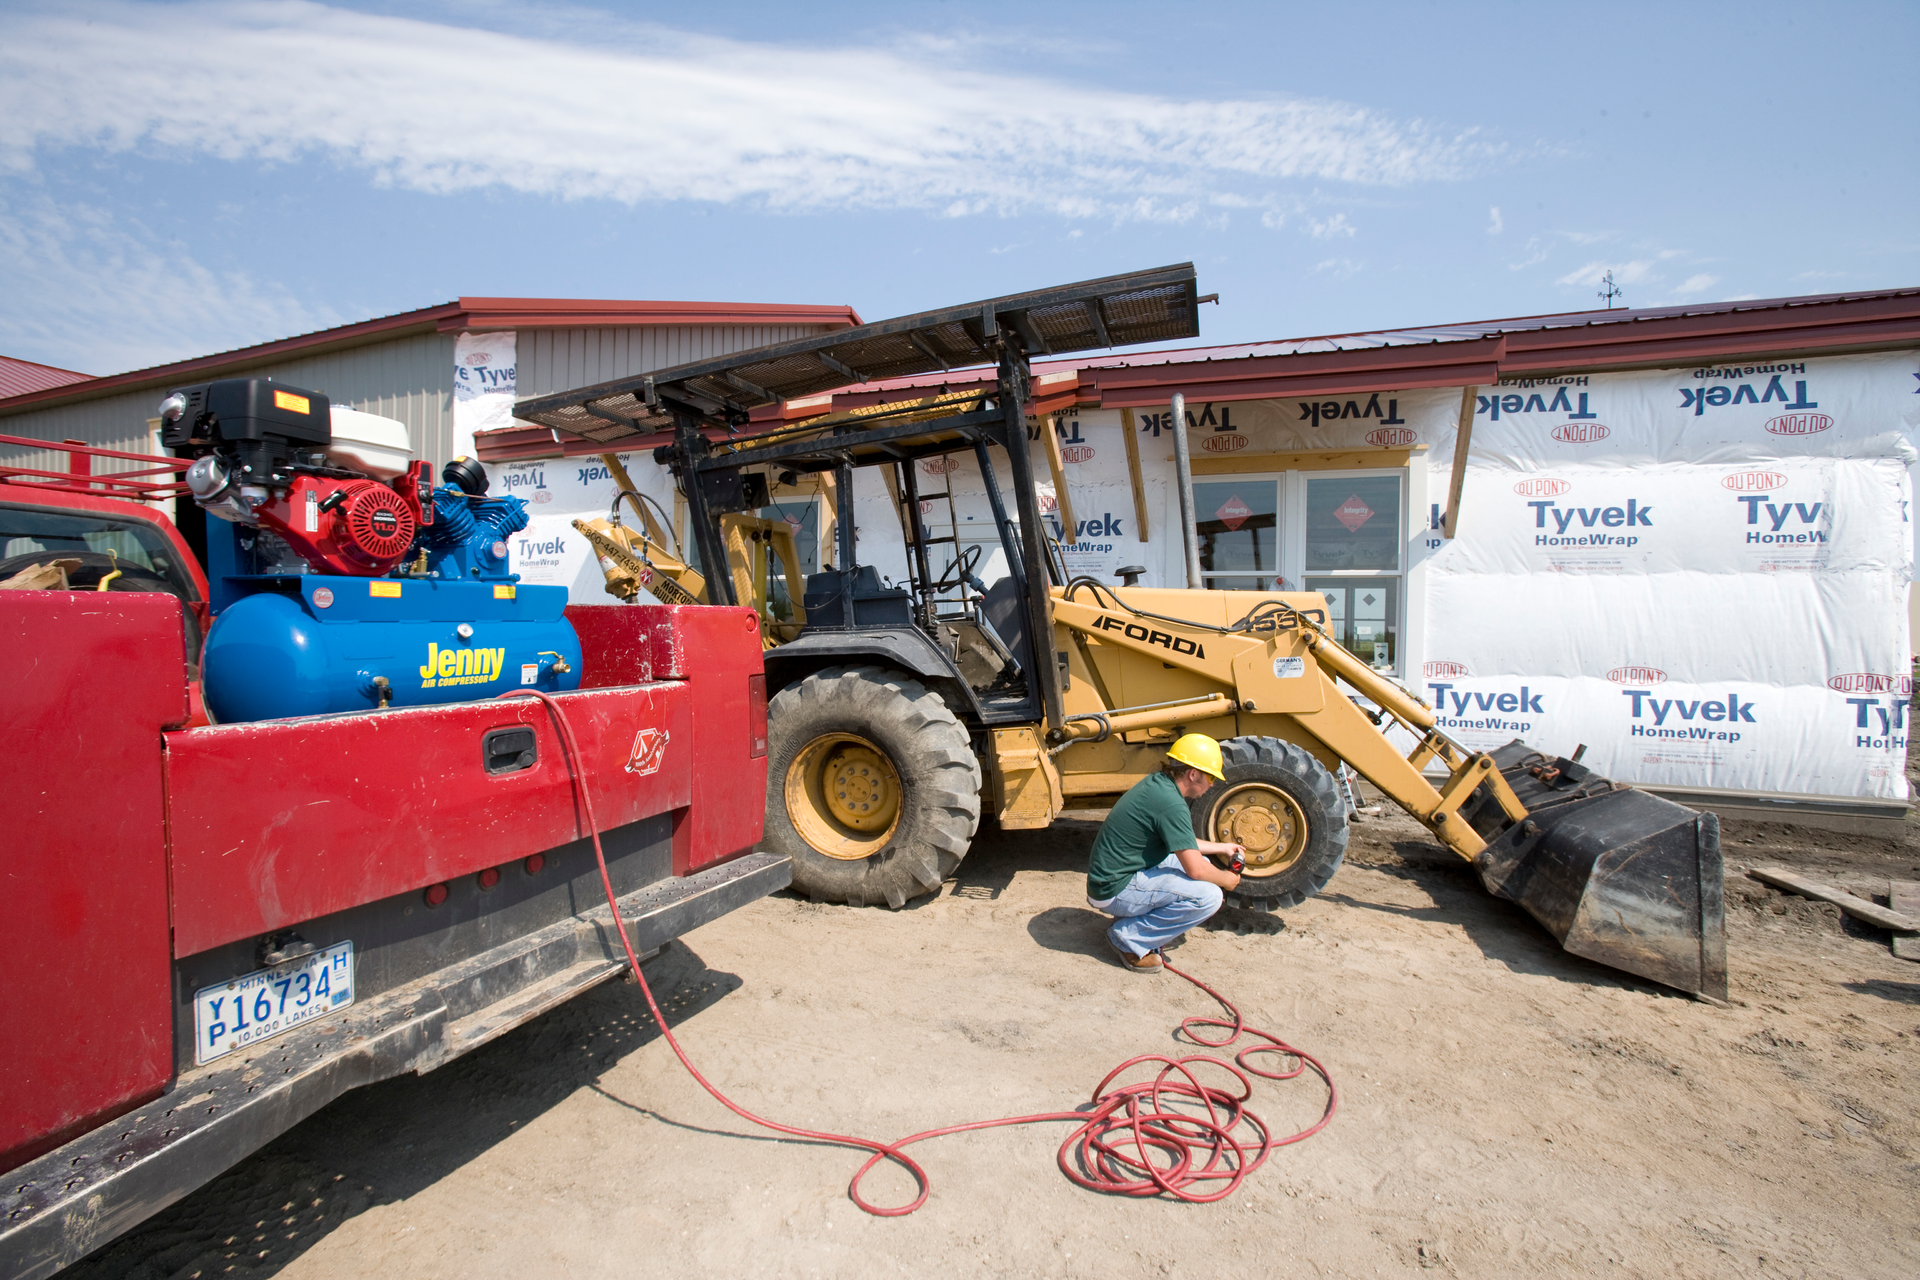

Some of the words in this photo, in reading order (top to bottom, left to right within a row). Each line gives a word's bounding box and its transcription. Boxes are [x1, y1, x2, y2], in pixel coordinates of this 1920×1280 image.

[473, 364, 516, 386] Tyve
[1693, 362, 1806, 379] HomeWrap
[1477, 387, 1597, 421] Tyvek
[1679, 375, 1818, 416] Tyvek
[1299, 393, 1405, 427] Tyvek
[503, 469, 547, 491] Tyvek
[1344, 506, 1368, 515] Integrity
[1528, 499, 1653, 534] Tyvek
[373, 522, 395, 531] 11.0
[519, 536, 566, 559] Tyvek
[579, 524, 640, 574] 1-800-447-7436
[1050, 542, 1113, 554] omeWrap
[1535, 534, 1638, 547] HomeWrap
[519, 558, 560, 567] HomeWrap
[1102, 618, 1197, 655] FORD
[419, 642, 505, 681] Jenny
[421, 678, 436, 688] AIR
[438, 675, 489, 687] COMPRESSOR
[1428, 683, 1544, 716] Tyvek
[1622, 690, 1757, 725] Tyvek
[1436, 716, 1531, 733] HomeWrap
[1631, 725, 1741, 743] HomeWrap
[231, 965, 331, 1034] 16734
[285, 1003, 321, 1025] LAKES
